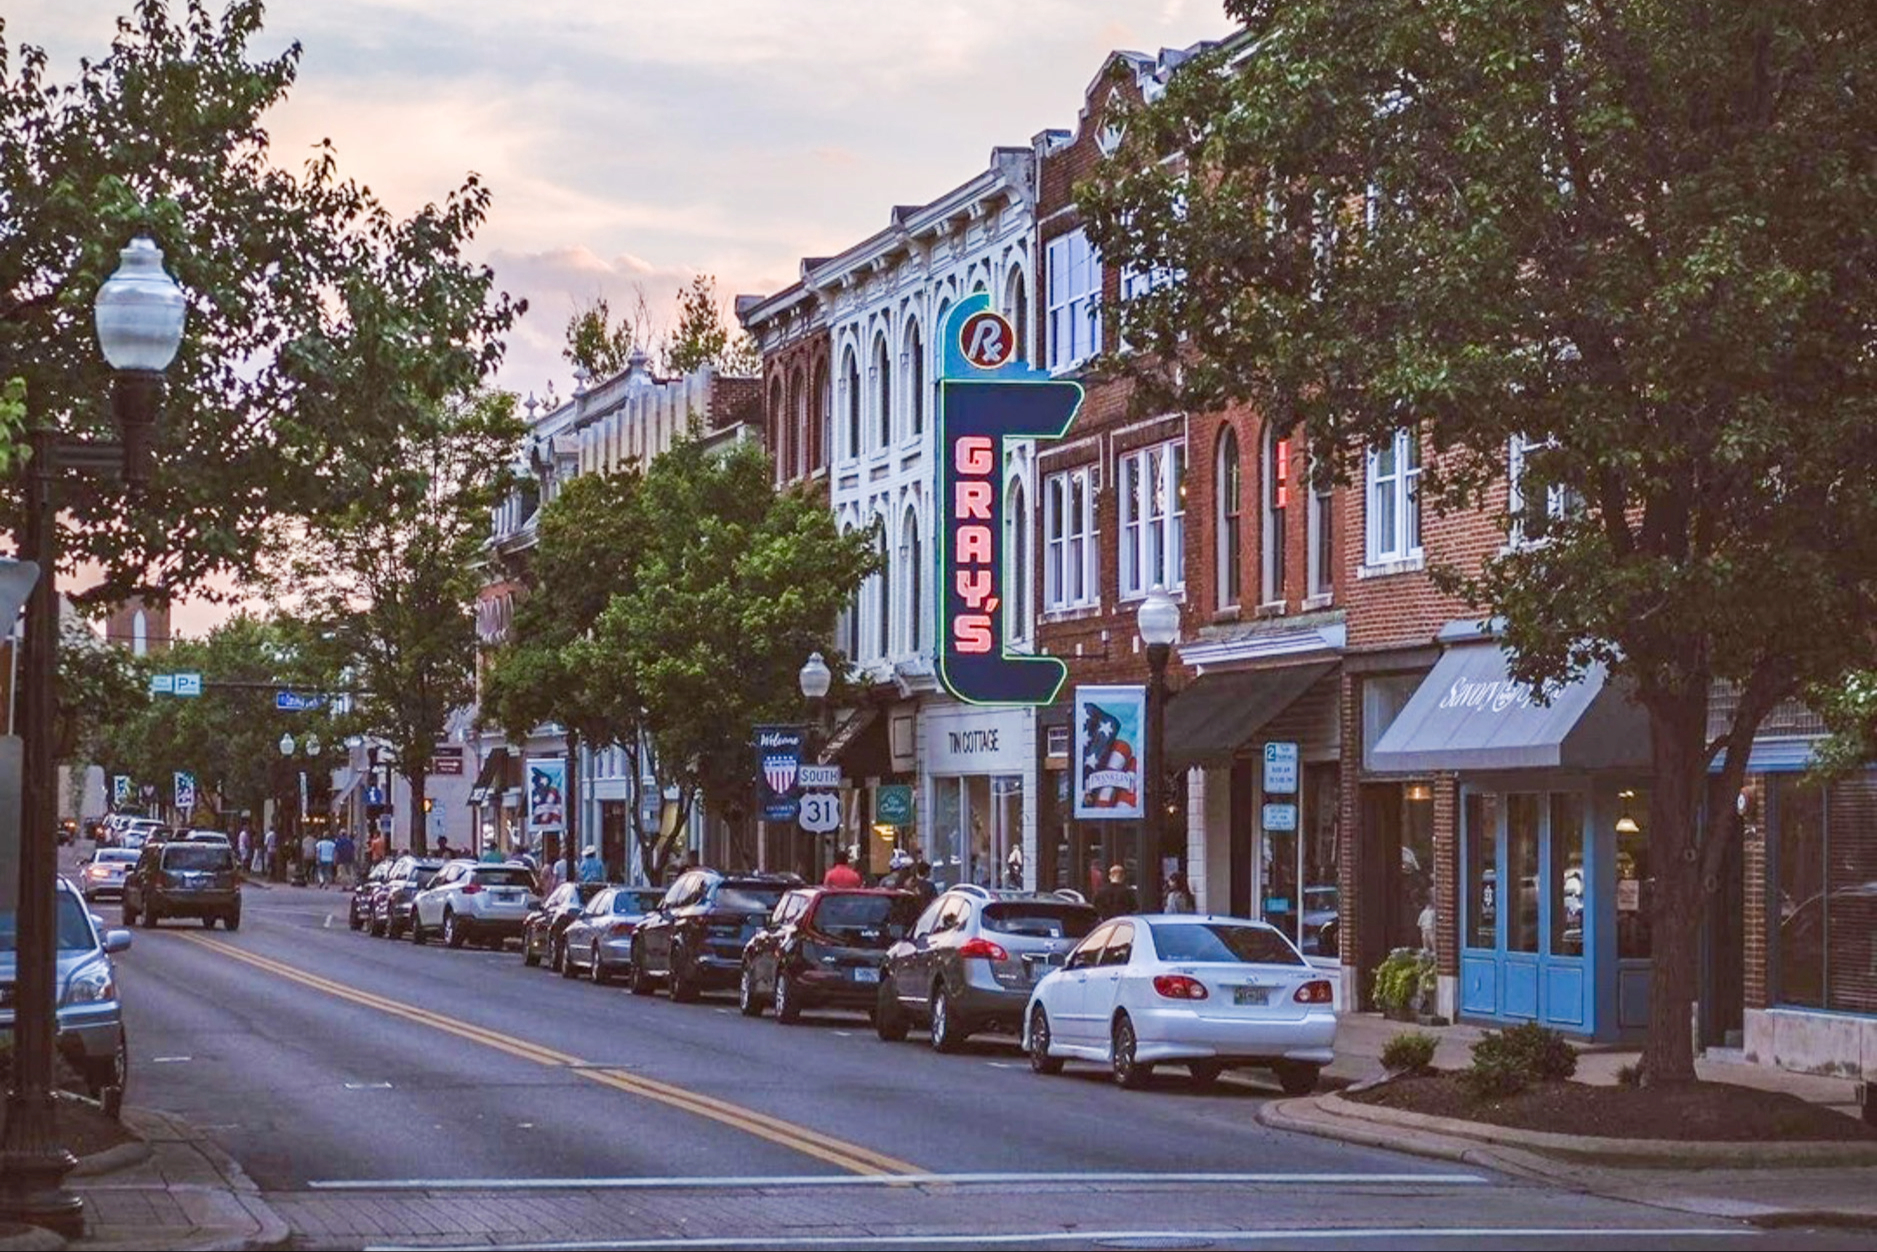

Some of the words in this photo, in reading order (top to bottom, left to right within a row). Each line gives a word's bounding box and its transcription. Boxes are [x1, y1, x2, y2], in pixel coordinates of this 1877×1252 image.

[953, 436, 999, 653] GRAY'S
[760, 732, 799, 748] Welcome
[948, 731, 961, 754] TIN
[962, 728, 999, 754] COTTAGE
[801, 768, 838, 783] SOUTH
[806, 800, 831, 824] 31
